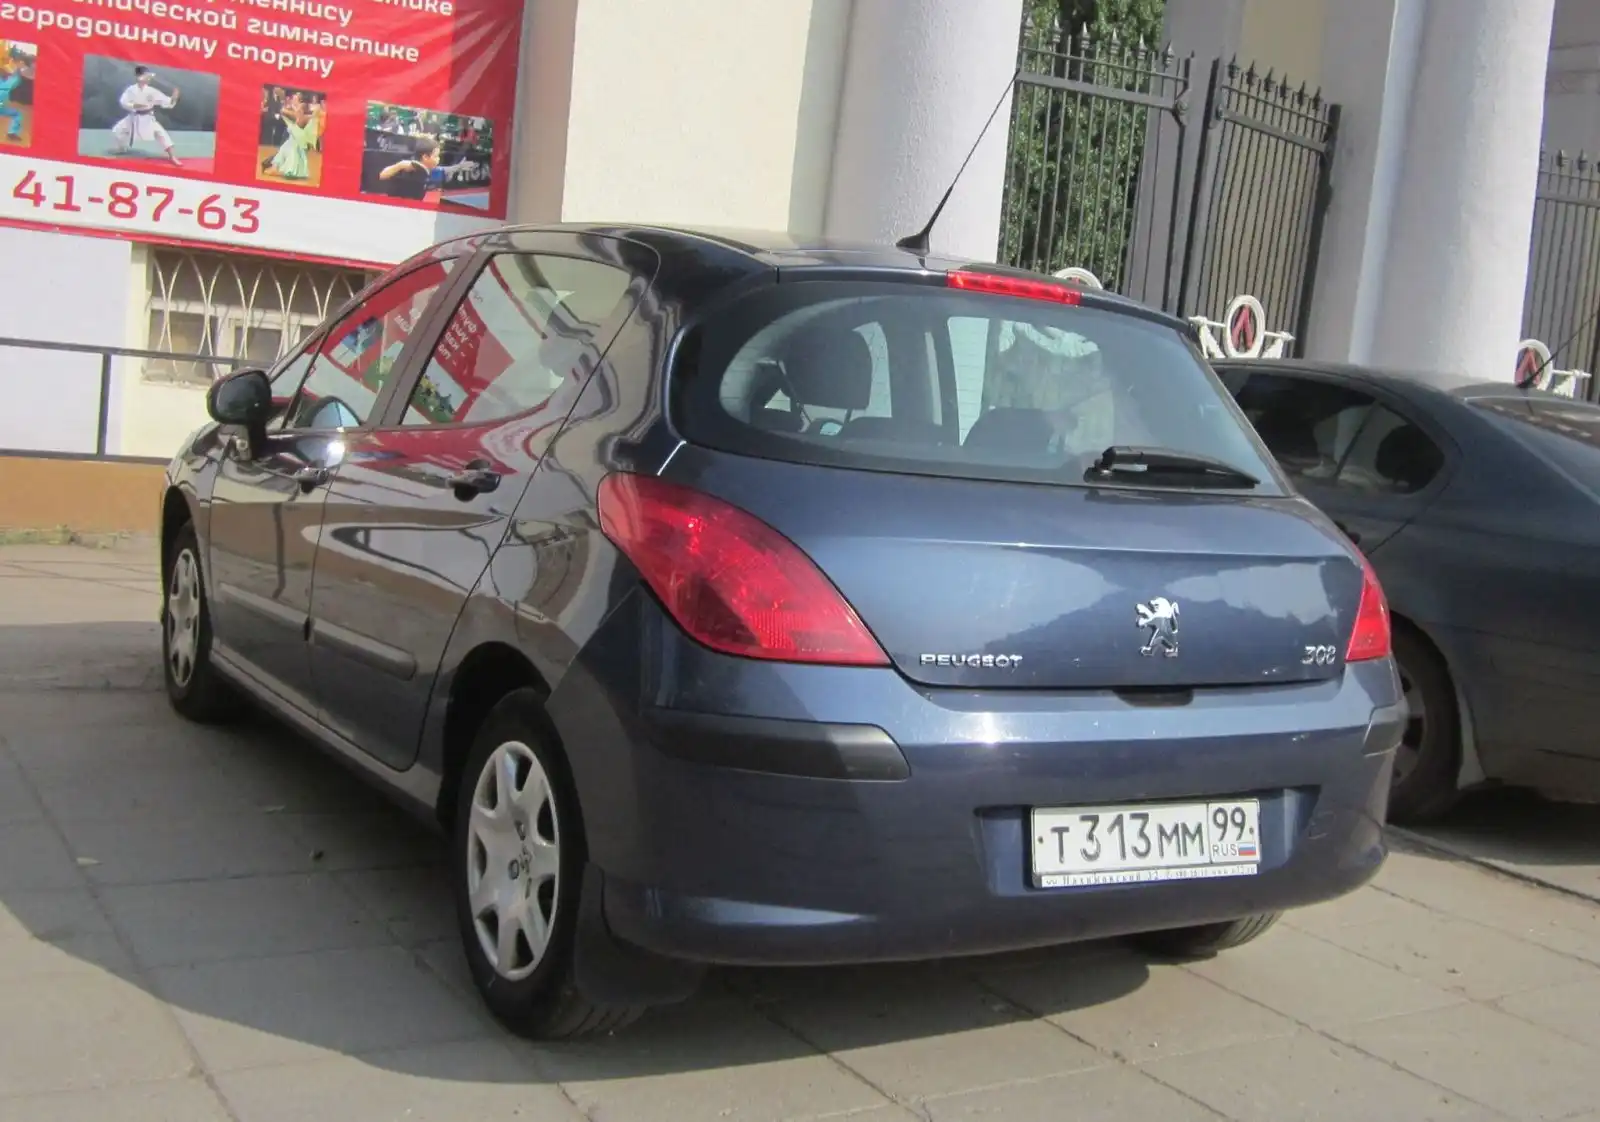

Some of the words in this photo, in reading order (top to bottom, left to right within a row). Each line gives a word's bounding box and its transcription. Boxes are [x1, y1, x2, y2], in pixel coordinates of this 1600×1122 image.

[231, 0, 352, 27] еннису
[373, 0, 453, 16] ике
[0, 3, 218, 59] городошному
[227, 42, 334, 78] спорту
[72, 0, 237, 29] ической
[247, 17, 419, 62] гимнастике
[13, 170, 260, 233] 41-87-63
[919, 653, 1023, 668] PEUGEOT
[1301, 645, 1336, 667] 308
[1212, 806, 1246, 842] 99
[1212, 843, 1238, 857] RUS
